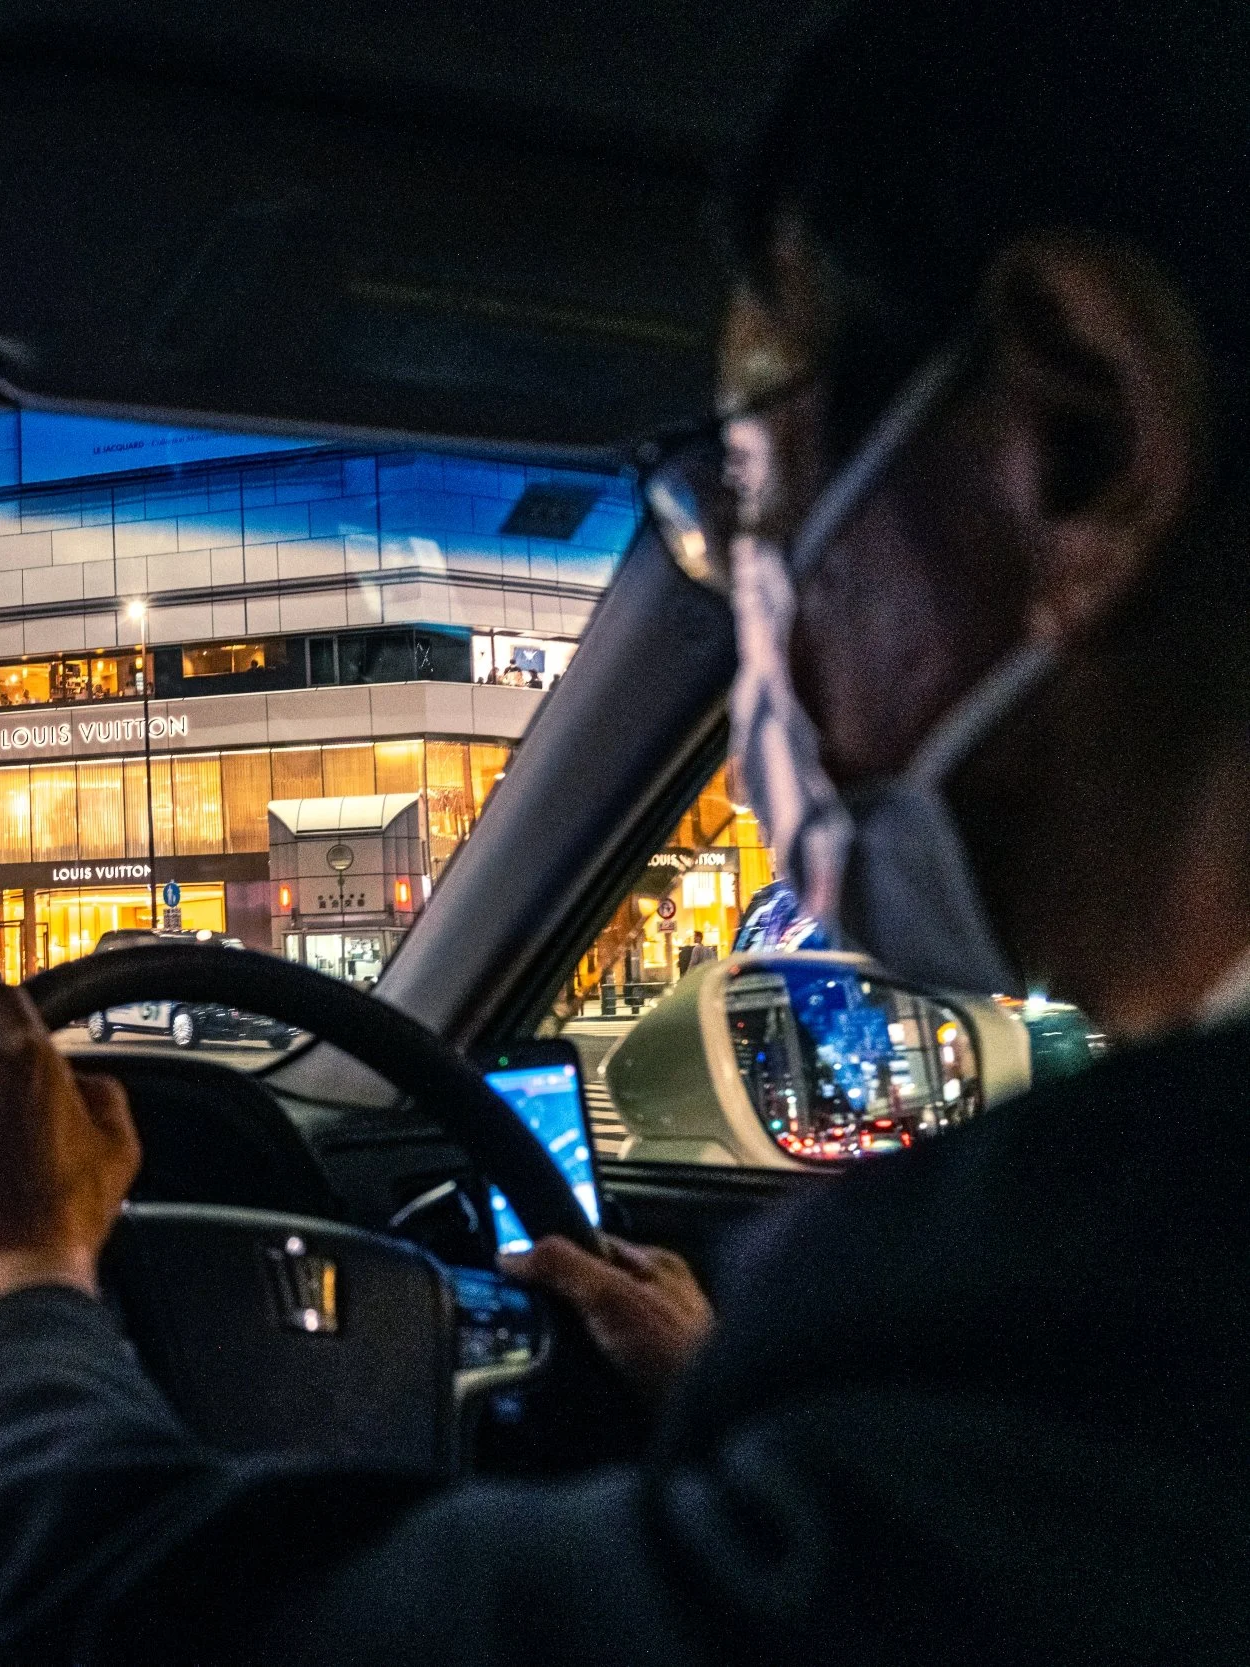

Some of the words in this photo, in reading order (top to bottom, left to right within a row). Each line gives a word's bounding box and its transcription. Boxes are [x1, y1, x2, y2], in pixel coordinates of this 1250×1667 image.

[102, 441, 145, 453] JACQUARD
[0, 722, 72, 750] LOUIS
[78, 714, 189, 744] VUITTON
[52, 867, 92, 882] LOUIS
